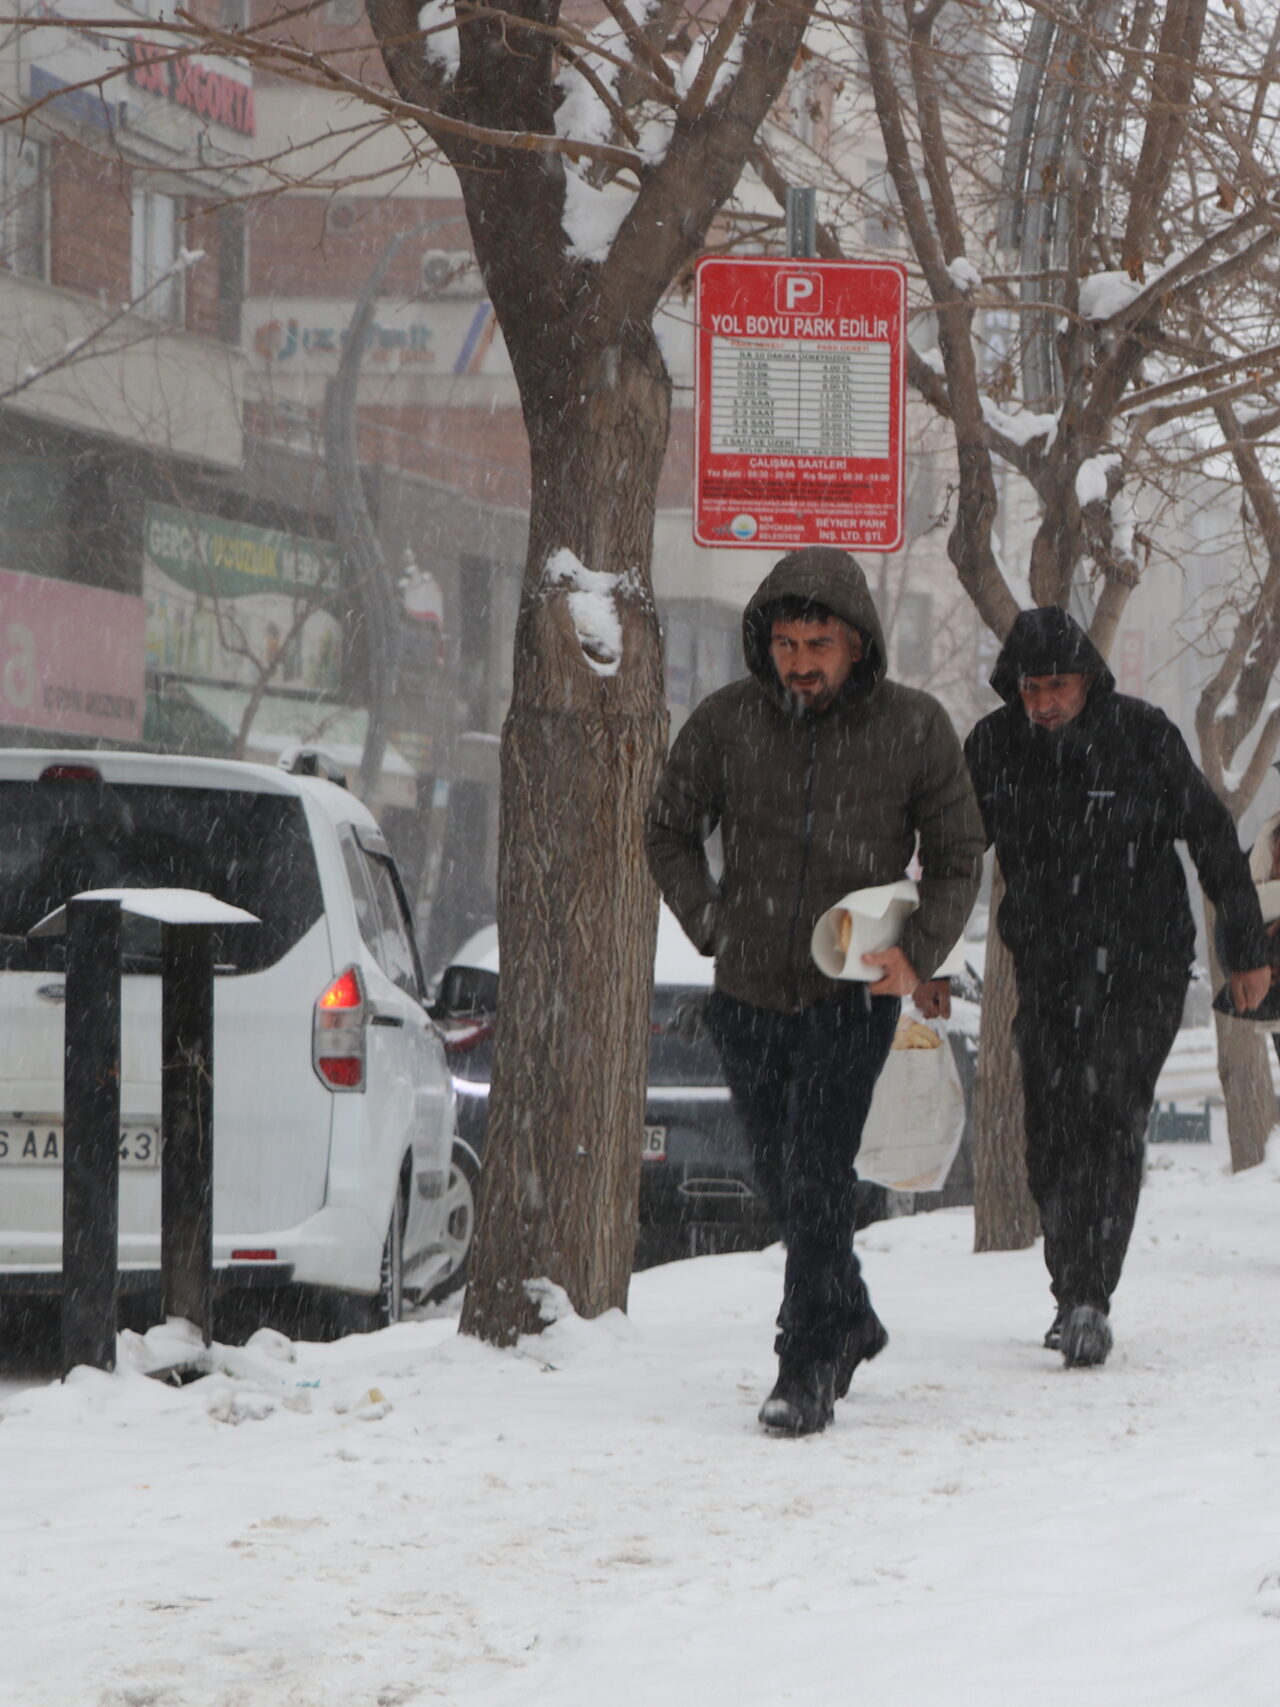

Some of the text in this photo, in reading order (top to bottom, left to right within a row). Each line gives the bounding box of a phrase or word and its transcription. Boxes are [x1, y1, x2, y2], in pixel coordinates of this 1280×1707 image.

[786, 278, 814, 310] P
[711, 315, 888, 338] YOL BOYU PARK EDİLİR
[749, 458, 847, 470] ÇALIŞMA SAATLERİ
[816, 517, 887, 529] BEYNER PARK
